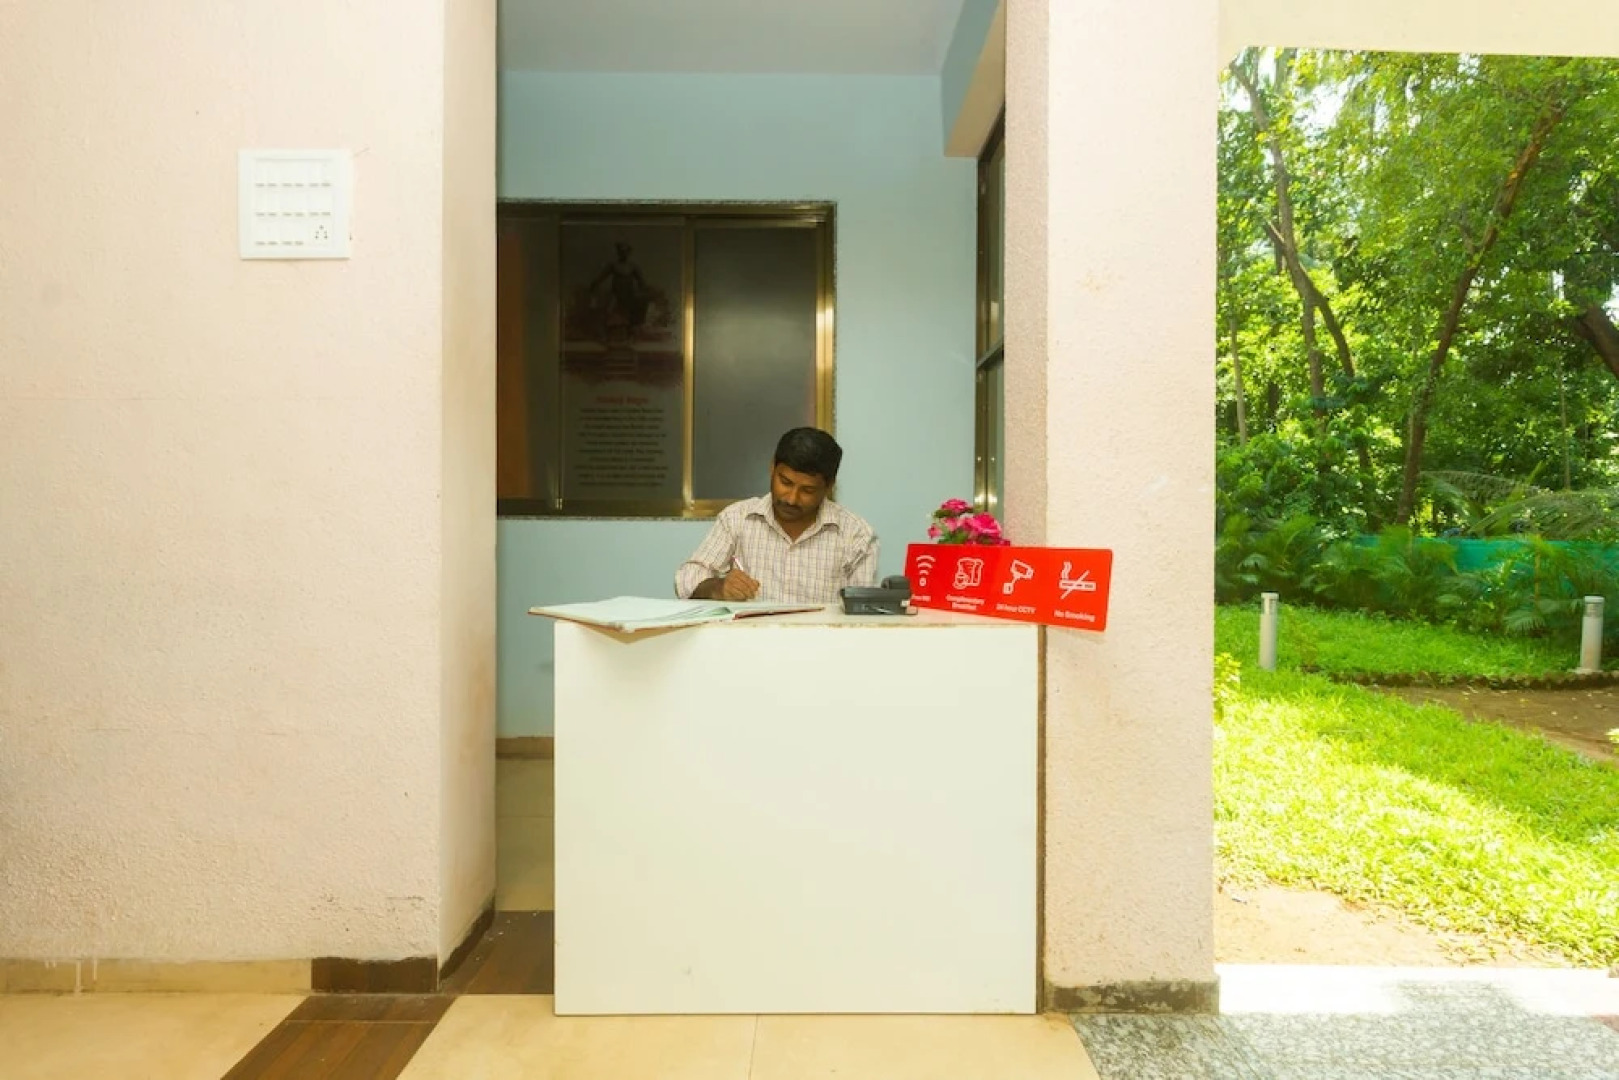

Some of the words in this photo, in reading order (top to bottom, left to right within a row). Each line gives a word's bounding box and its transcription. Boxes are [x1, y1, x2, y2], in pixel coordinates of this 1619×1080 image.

[1018, 605, 1036, 614] CCTV
[1054, 610, 1064, 618] No
[1065, 611, 1095, 623] Smoking
